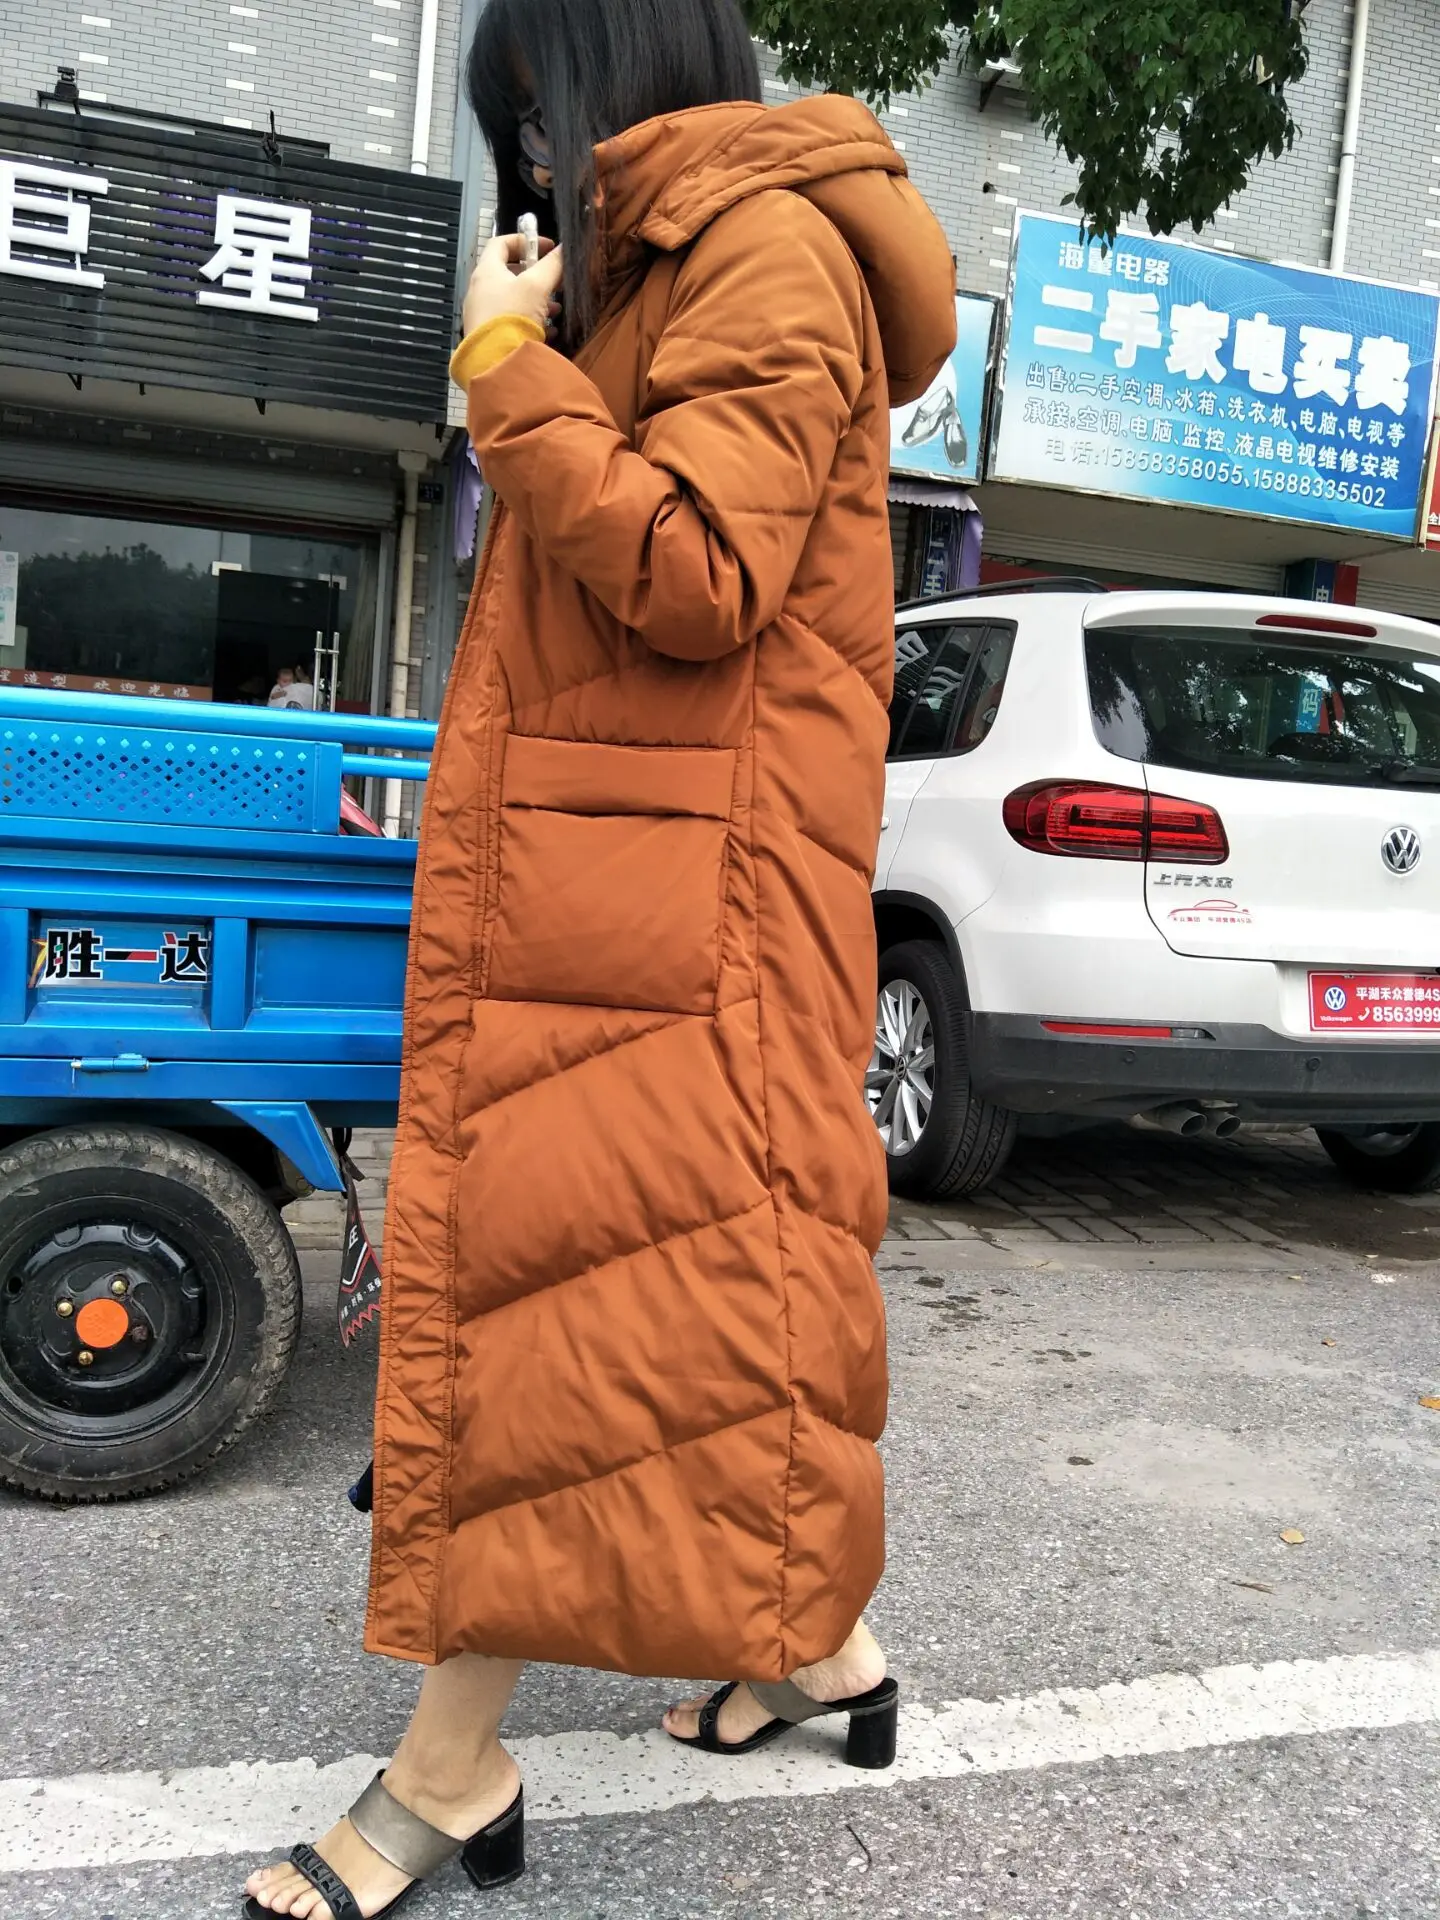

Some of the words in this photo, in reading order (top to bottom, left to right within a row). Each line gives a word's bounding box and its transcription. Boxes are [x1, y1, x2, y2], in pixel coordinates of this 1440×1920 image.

[0, 160, 319, 322] 巨星
[1033, 284, 1412, 415] 二手家电买卖
[1153, 873, 1234, 889] 上汽大众
[45, 928, 208, 983] 胜一达
